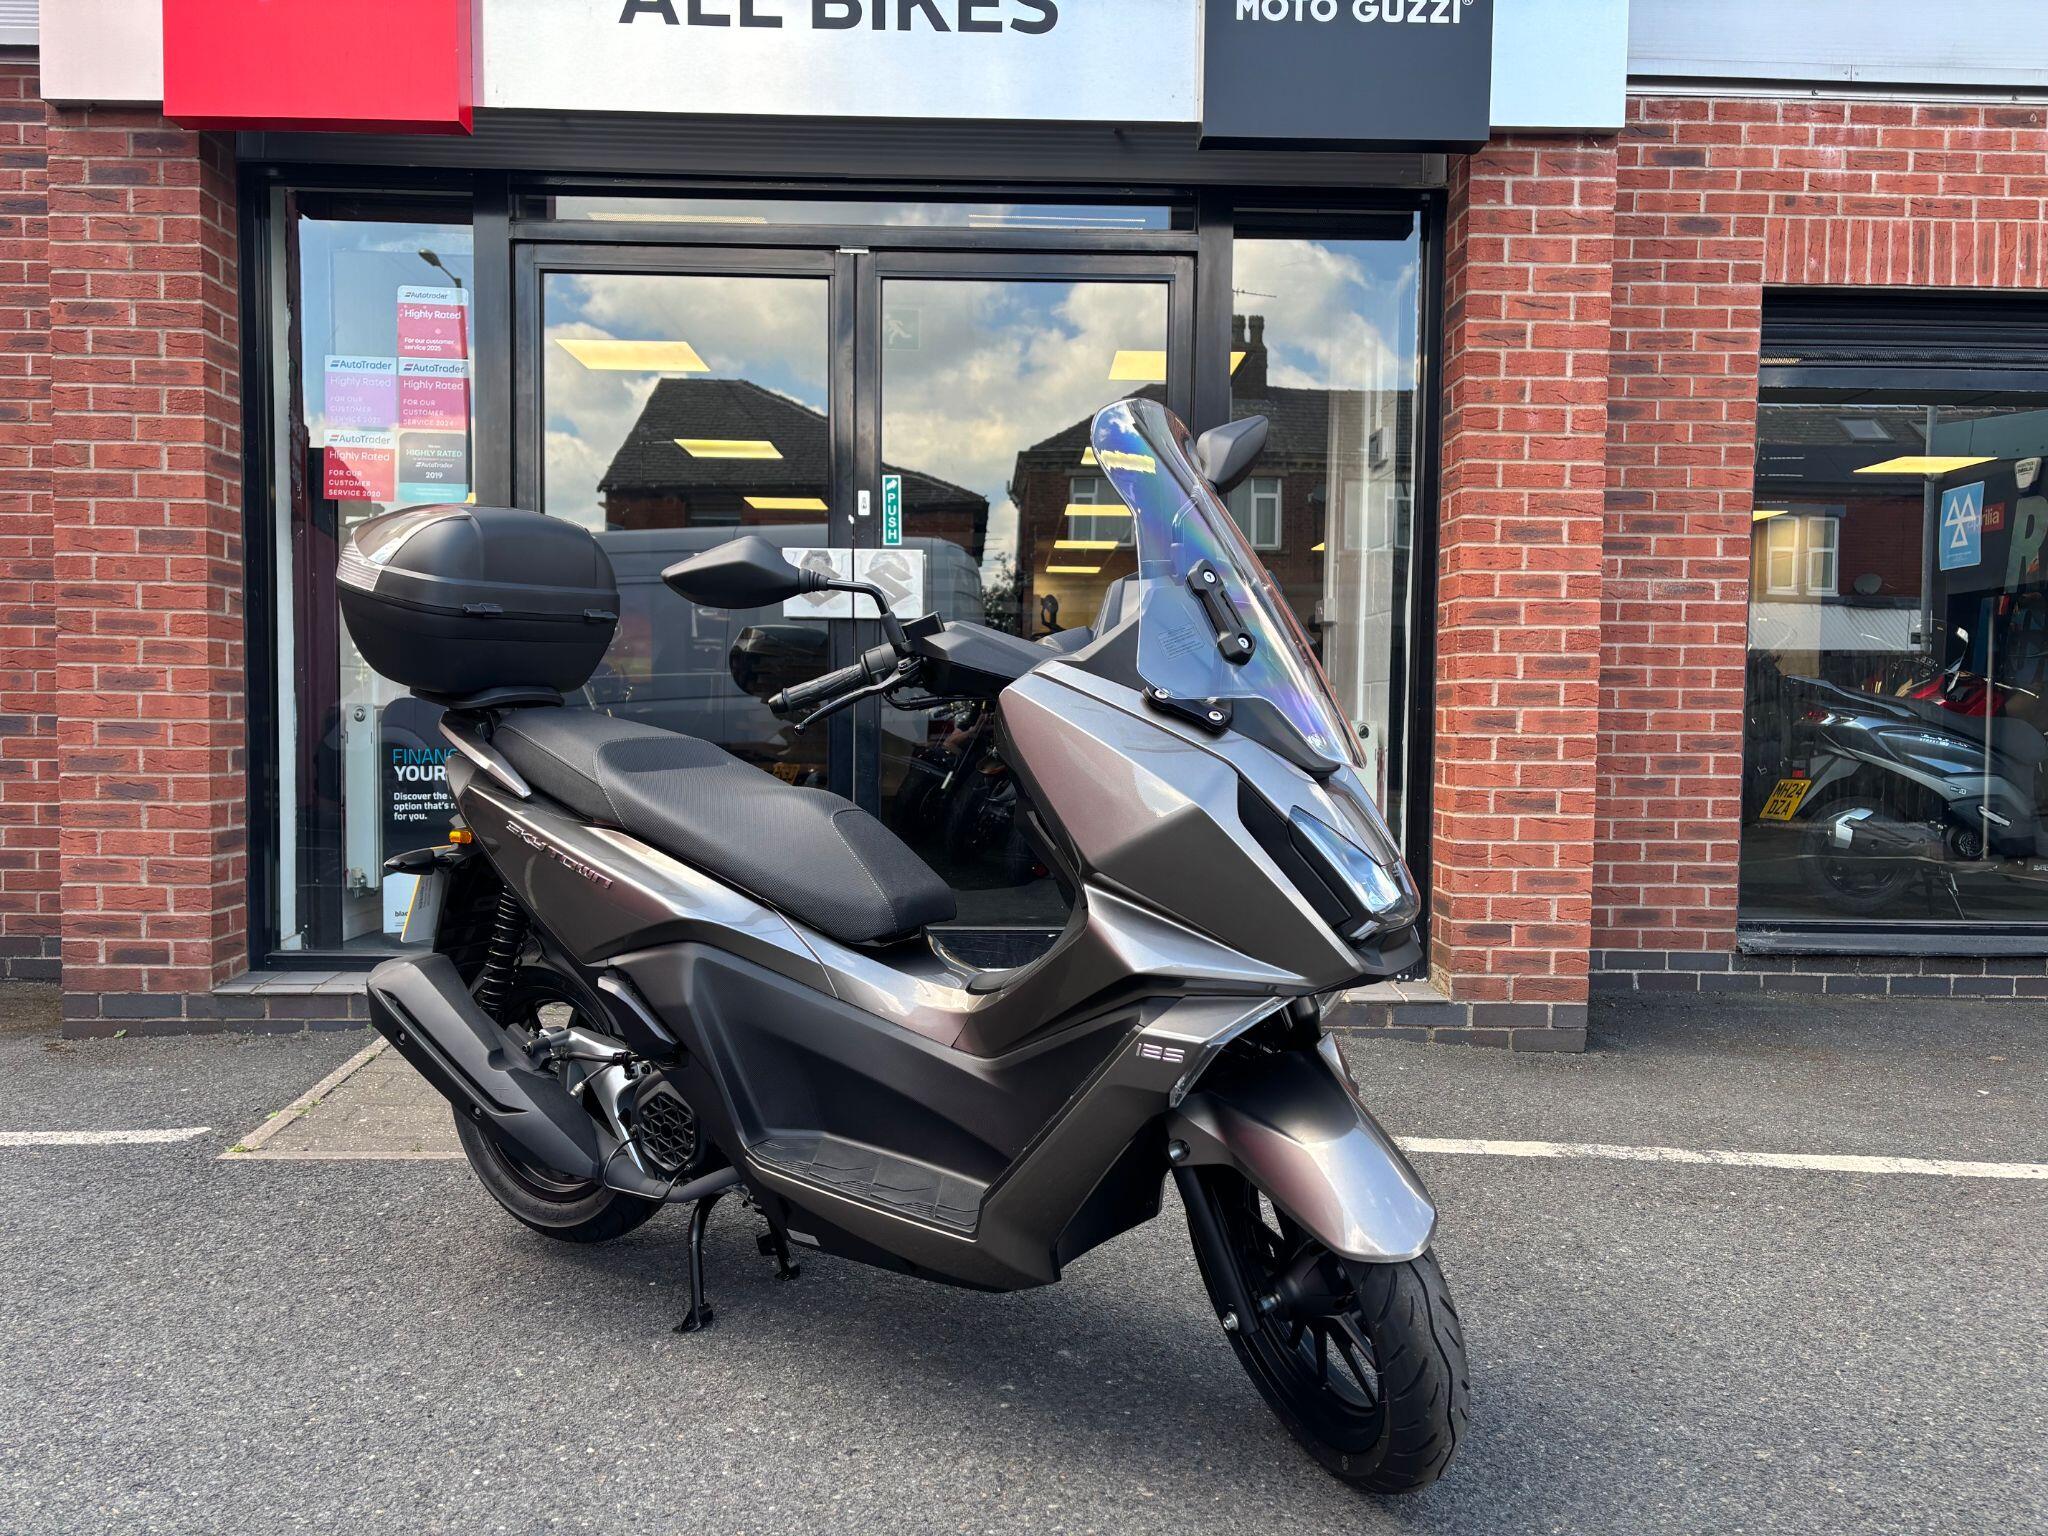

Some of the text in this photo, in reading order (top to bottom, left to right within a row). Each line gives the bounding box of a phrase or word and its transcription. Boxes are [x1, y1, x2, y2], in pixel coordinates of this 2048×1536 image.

[1236, 0, 1338, 22] MOTO
[404, 309, 461, 320] Highly Rated
[340, 360, 392, 370] AutoTrader
[413, 363, 464, 373] AutoTrader
[330, 376, 391, 387] Highly Rated
[403, 379, 463, 391] Highly Rated
[402, 408, 444, 417] CUSTOMER
[339, 434, 391, 445] AutoTrader
[329, 451, 390, 462] Highly Rated
[406, 449, 462, 458] HIGHLY RATED
[425, 471, 443, 479] 2019
[328, 479, 371, 487] CUSTOMER
[328, 489, 381, 498] SERVICE 2020
[887, 492, 897, 540] PUSH
[393, 765, 446, 782] YOUR
[393, 792, 431, 801] Discover
[433, 792, 448, 800] the
[393, 802, 422, 812] option
[424, 802, 449, 810] that's
[394, 813, 428, 822] for you.
[1135, 1042, 1186, 1064] 125
